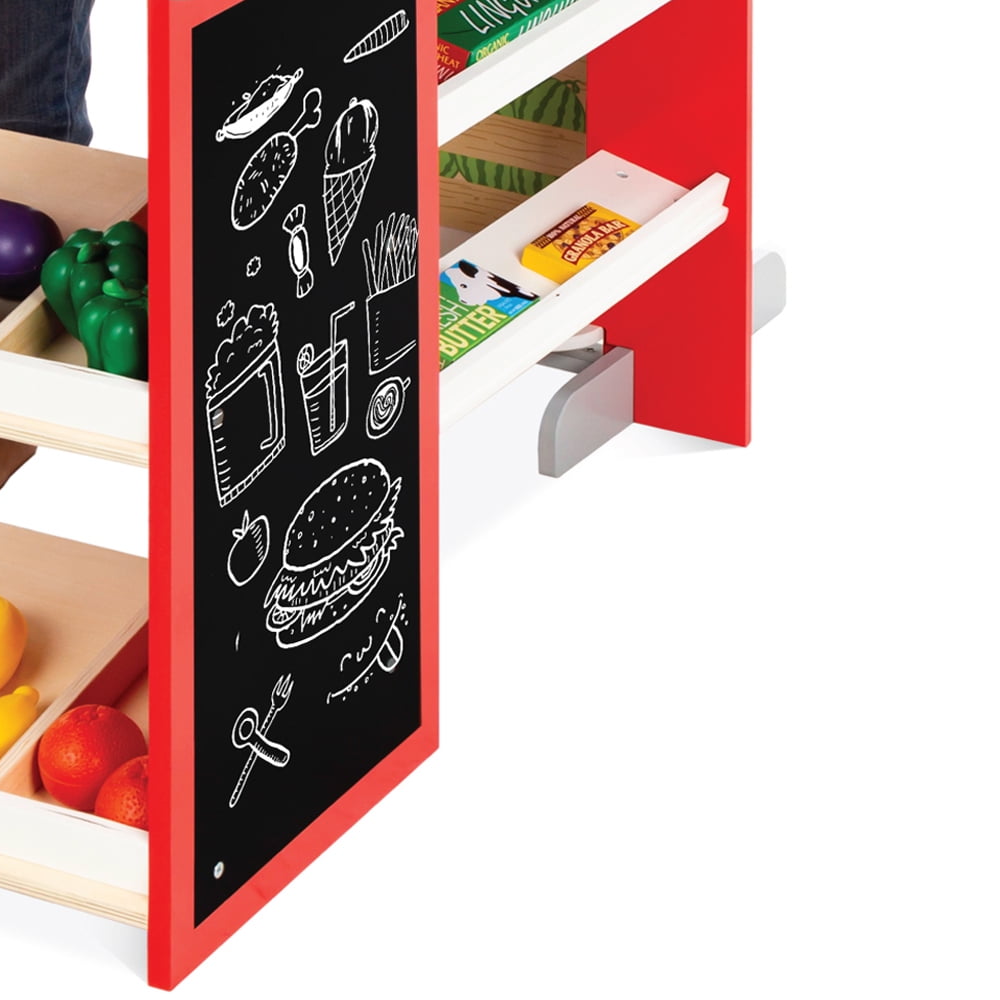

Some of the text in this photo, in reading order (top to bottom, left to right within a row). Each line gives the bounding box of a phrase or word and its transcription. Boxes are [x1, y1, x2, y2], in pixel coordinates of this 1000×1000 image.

[436, 53, 460, 69] HEAT
[563, 220, 627, 262] GRANOLA BAR
[439, 305, 508, 357] BUTTER
